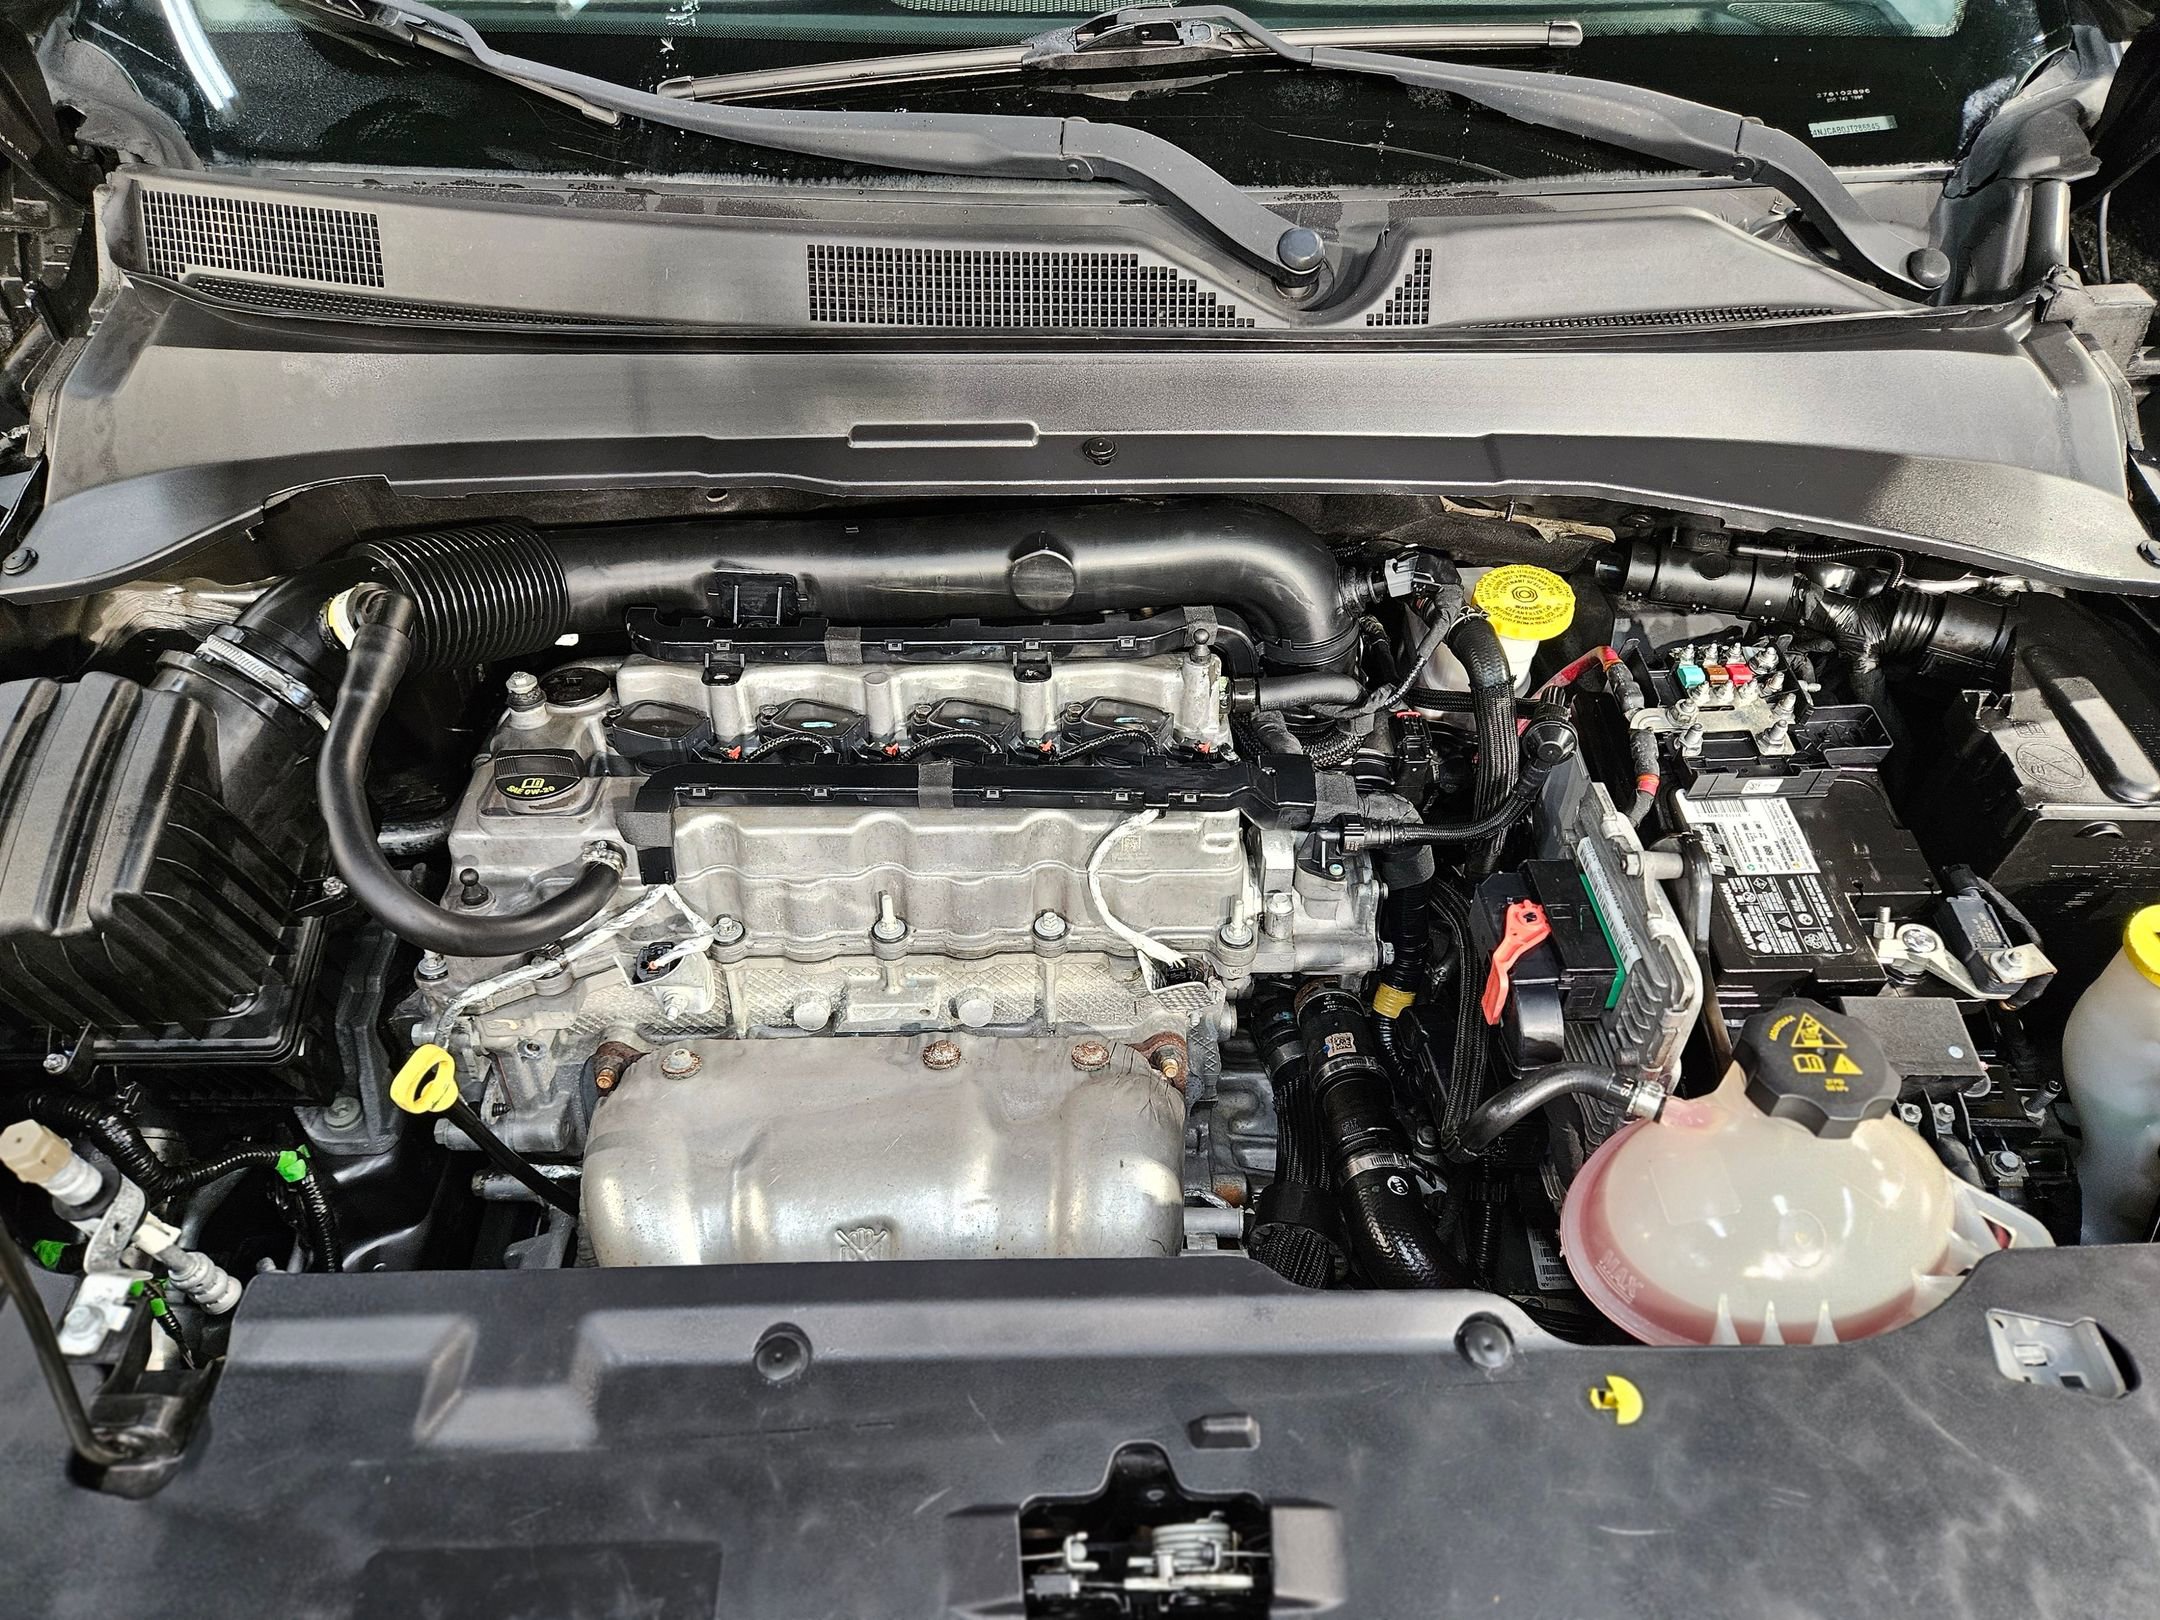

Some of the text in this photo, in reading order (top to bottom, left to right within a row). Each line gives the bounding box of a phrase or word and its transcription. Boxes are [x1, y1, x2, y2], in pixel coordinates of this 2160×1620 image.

[506, 785, 555, 795] SAE 0W-20
[1599, 1249, 1644, 1298] MAX
